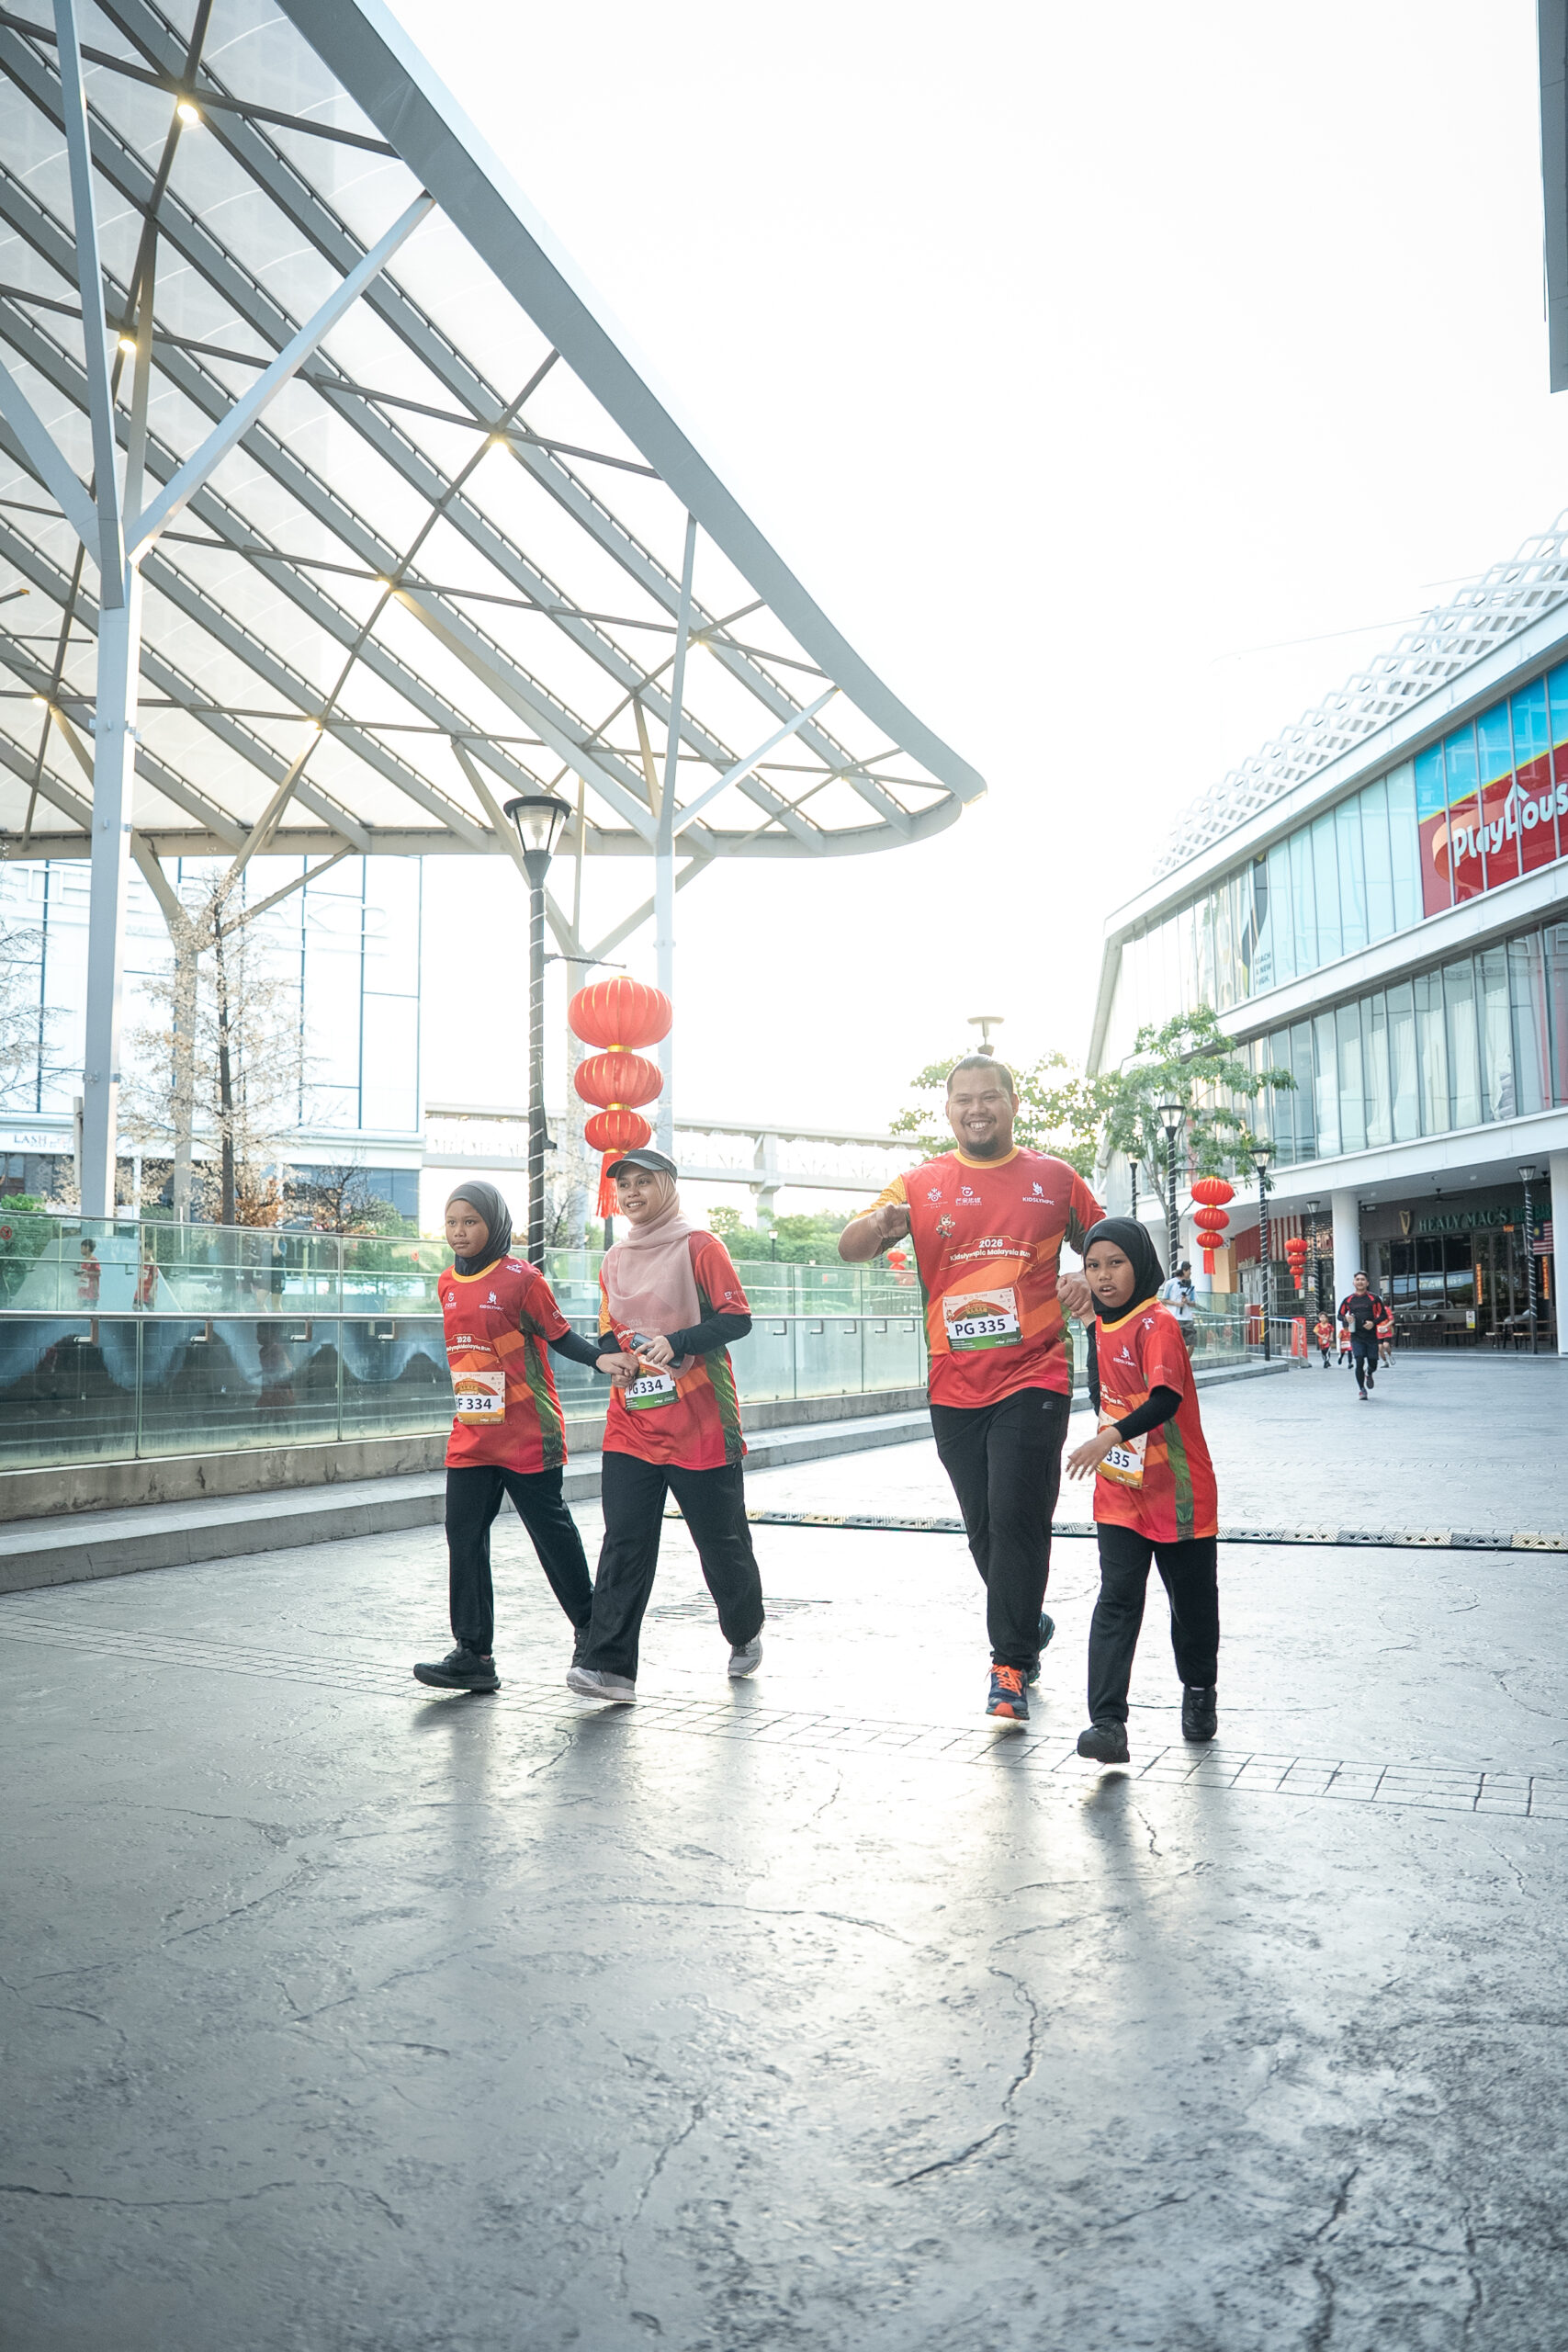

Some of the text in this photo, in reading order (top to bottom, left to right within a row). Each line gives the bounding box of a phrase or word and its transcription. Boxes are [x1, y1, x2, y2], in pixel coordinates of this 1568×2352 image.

[1022, 1196, 1055, 1205] KIDSLYMPIC
[1419, 1213, 1461, 1233] HEALY
[1466, 1206, 1508, 1227] MAC'S
[978, 1238, 1004, 1249] 2026
[950, 1250, 987, 1261] Kidslympic
[987, 1249, 1019, 1257] Malaysia
[955, 1318, 1006, 1337] PG 335
[628, 1379, 663, 1396] PG 334
[466, 1397, 492, 1410] 334
